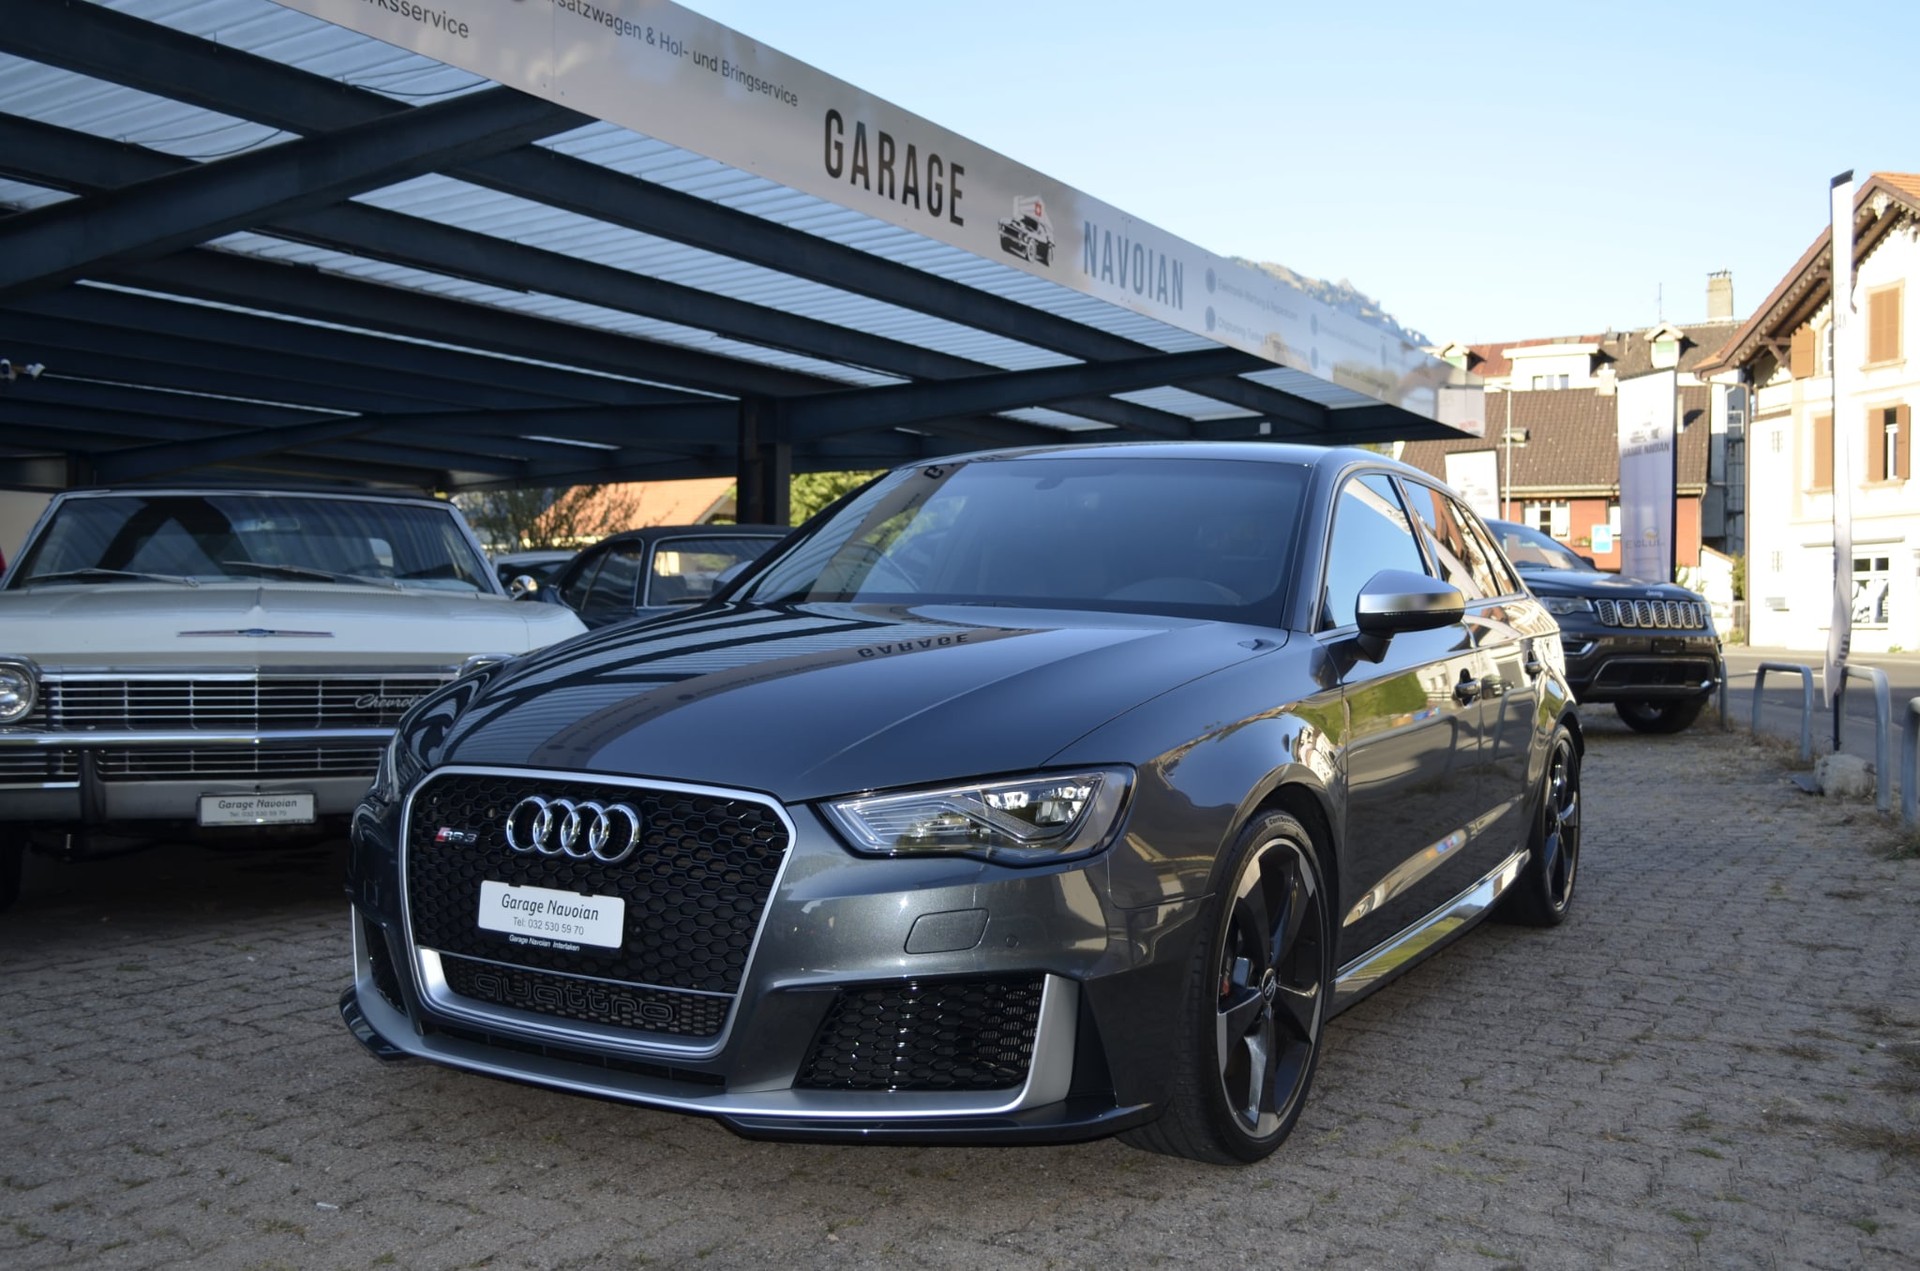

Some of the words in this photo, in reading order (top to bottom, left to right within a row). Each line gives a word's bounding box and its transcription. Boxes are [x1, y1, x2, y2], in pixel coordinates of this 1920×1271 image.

[362, 0, 469, 38] ksservice
[550, 0, 642, 40] satzwagen
[645, 27, 656, 46] &
[659, 32, 689, 58] Hol-
[693, 50, 718, 72] und
[721, 59, 798, 107] Bringservice
[824, 108, 965, 227] GARAGE
[1083, 220, 1184, 311] NAVOIAN
[354, 693, 420, 709] Chevrol
[218, 800, 254, 810] Garage
[256, 799, 298, 809] Navoian
[501, 893, 544, 916] Garage
[546, 900, 599, 921] Navoian
[513, 916, 526, 927] Tel:
[527, 918, 543, 930] 032
[544, 920, 560, 932] 530
[561, 922, 572, 934] 59
[574, 925, 585, 936] 70
[508, 934, 528, 945] Garage
[529, 937, 551, 948] Navoian
[474, 973, 674, 1023] quattro
